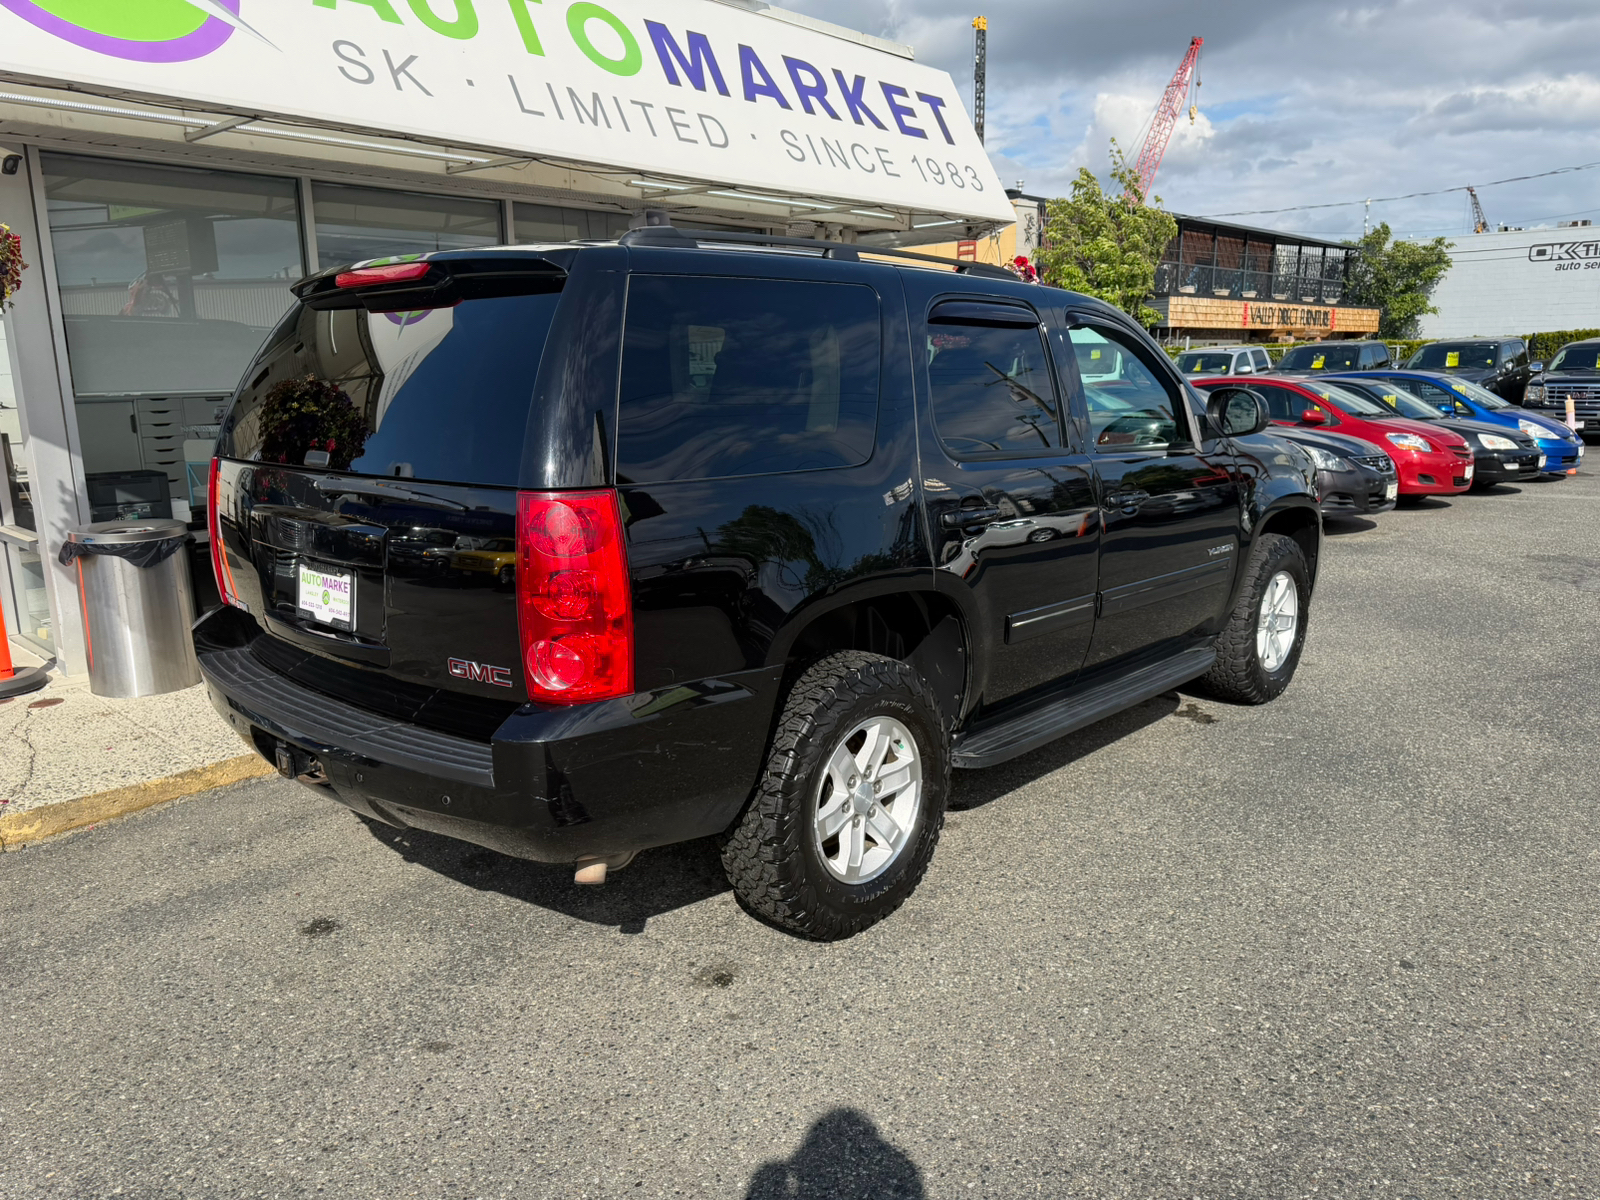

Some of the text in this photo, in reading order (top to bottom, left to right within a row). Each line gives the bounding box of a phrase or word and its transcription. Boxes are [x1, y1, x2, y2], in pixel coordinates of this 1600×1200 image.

[332, 39, 984, 192] SK LIMITED SINCE 1983
[1528, 241, 1600, 262] OK TI
[1555, 262, 1581, 271] auto
[1250, 306, 1276, 325] VALLEY
[301, 572, 350, 594] AUTOMARKE
[448, 657, 513, 687] GMC
